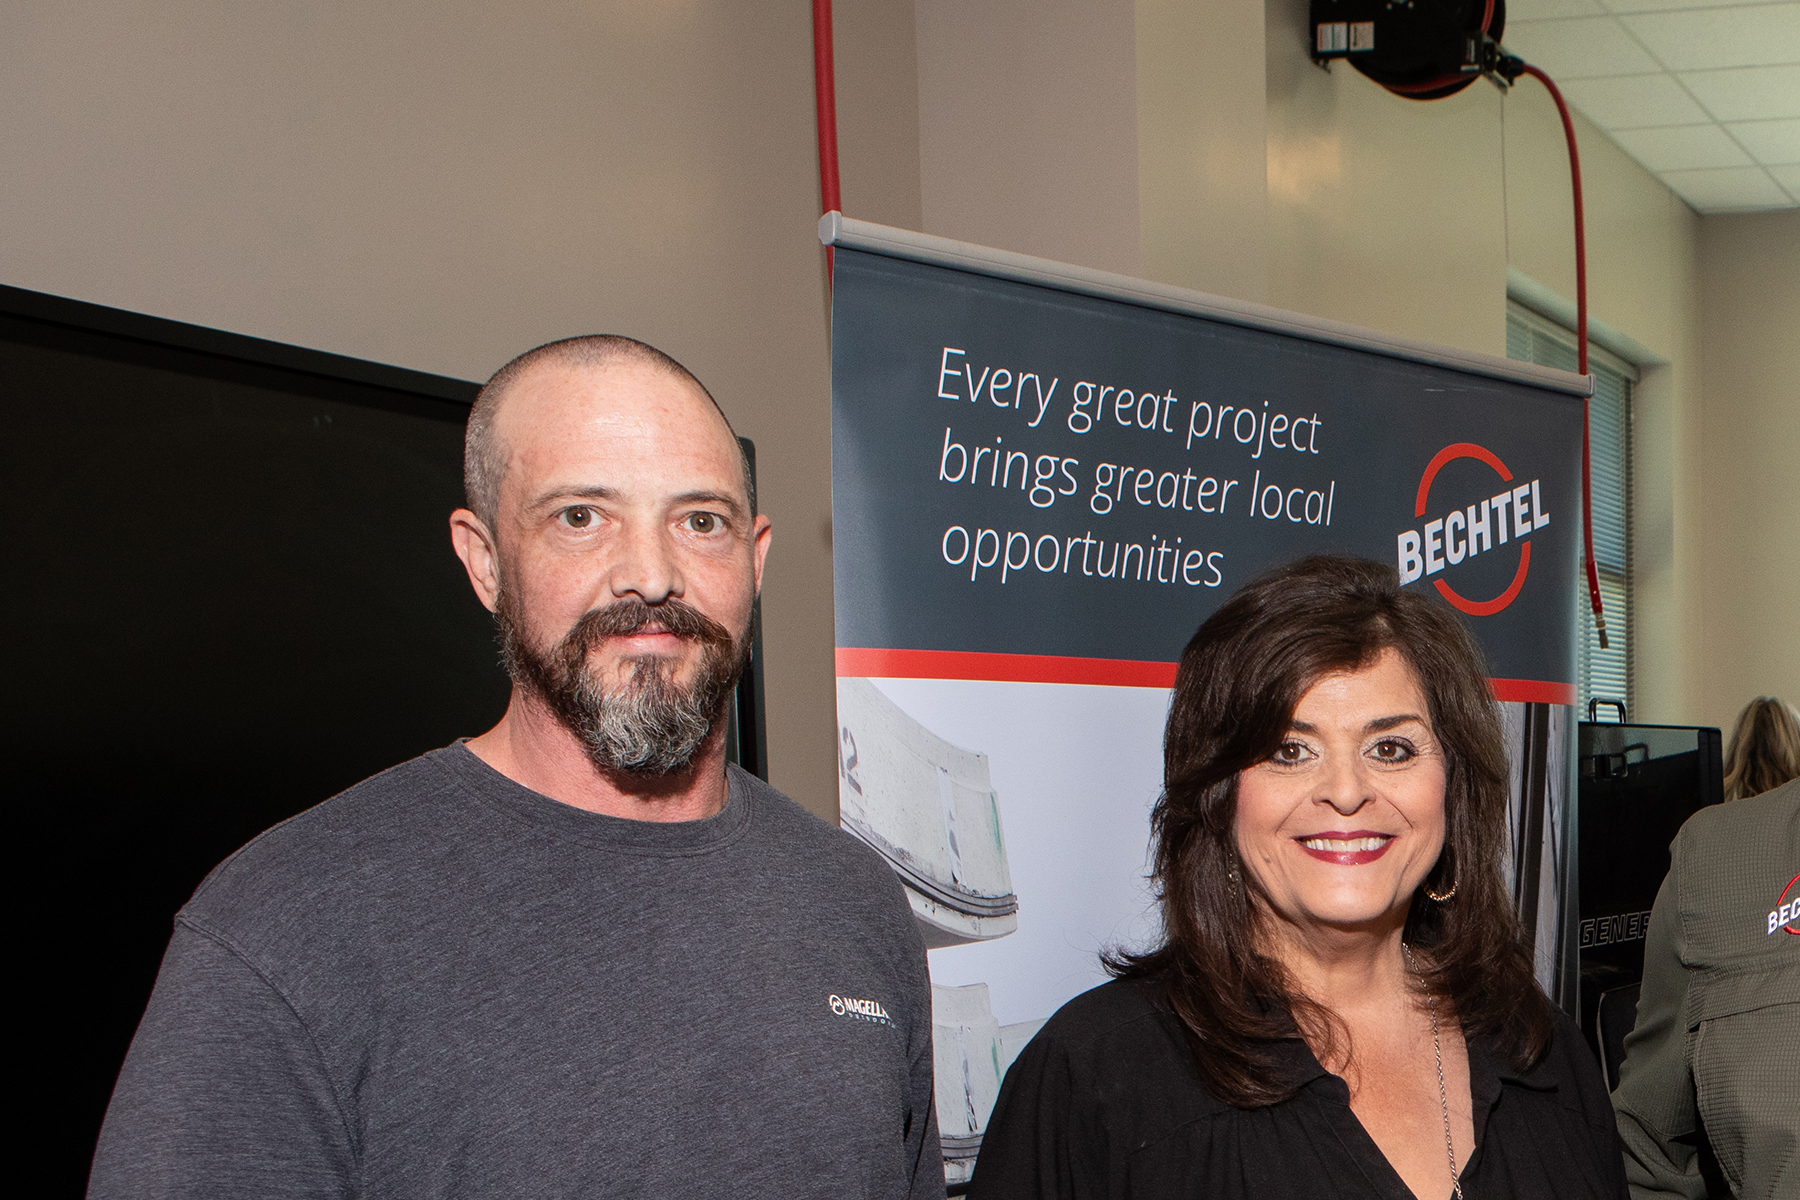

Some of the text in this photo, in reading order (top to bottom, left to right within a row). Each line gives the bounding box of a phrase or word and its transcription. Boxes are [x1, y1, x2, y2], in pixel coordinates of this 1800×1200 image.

[937, 347, 1322, 459] Every great project
[939, 427, 1335, 526] brings greater local
[942, 525, 1224, 587] opportunities
[1397, 479, 1549, 587] BECHTEL
